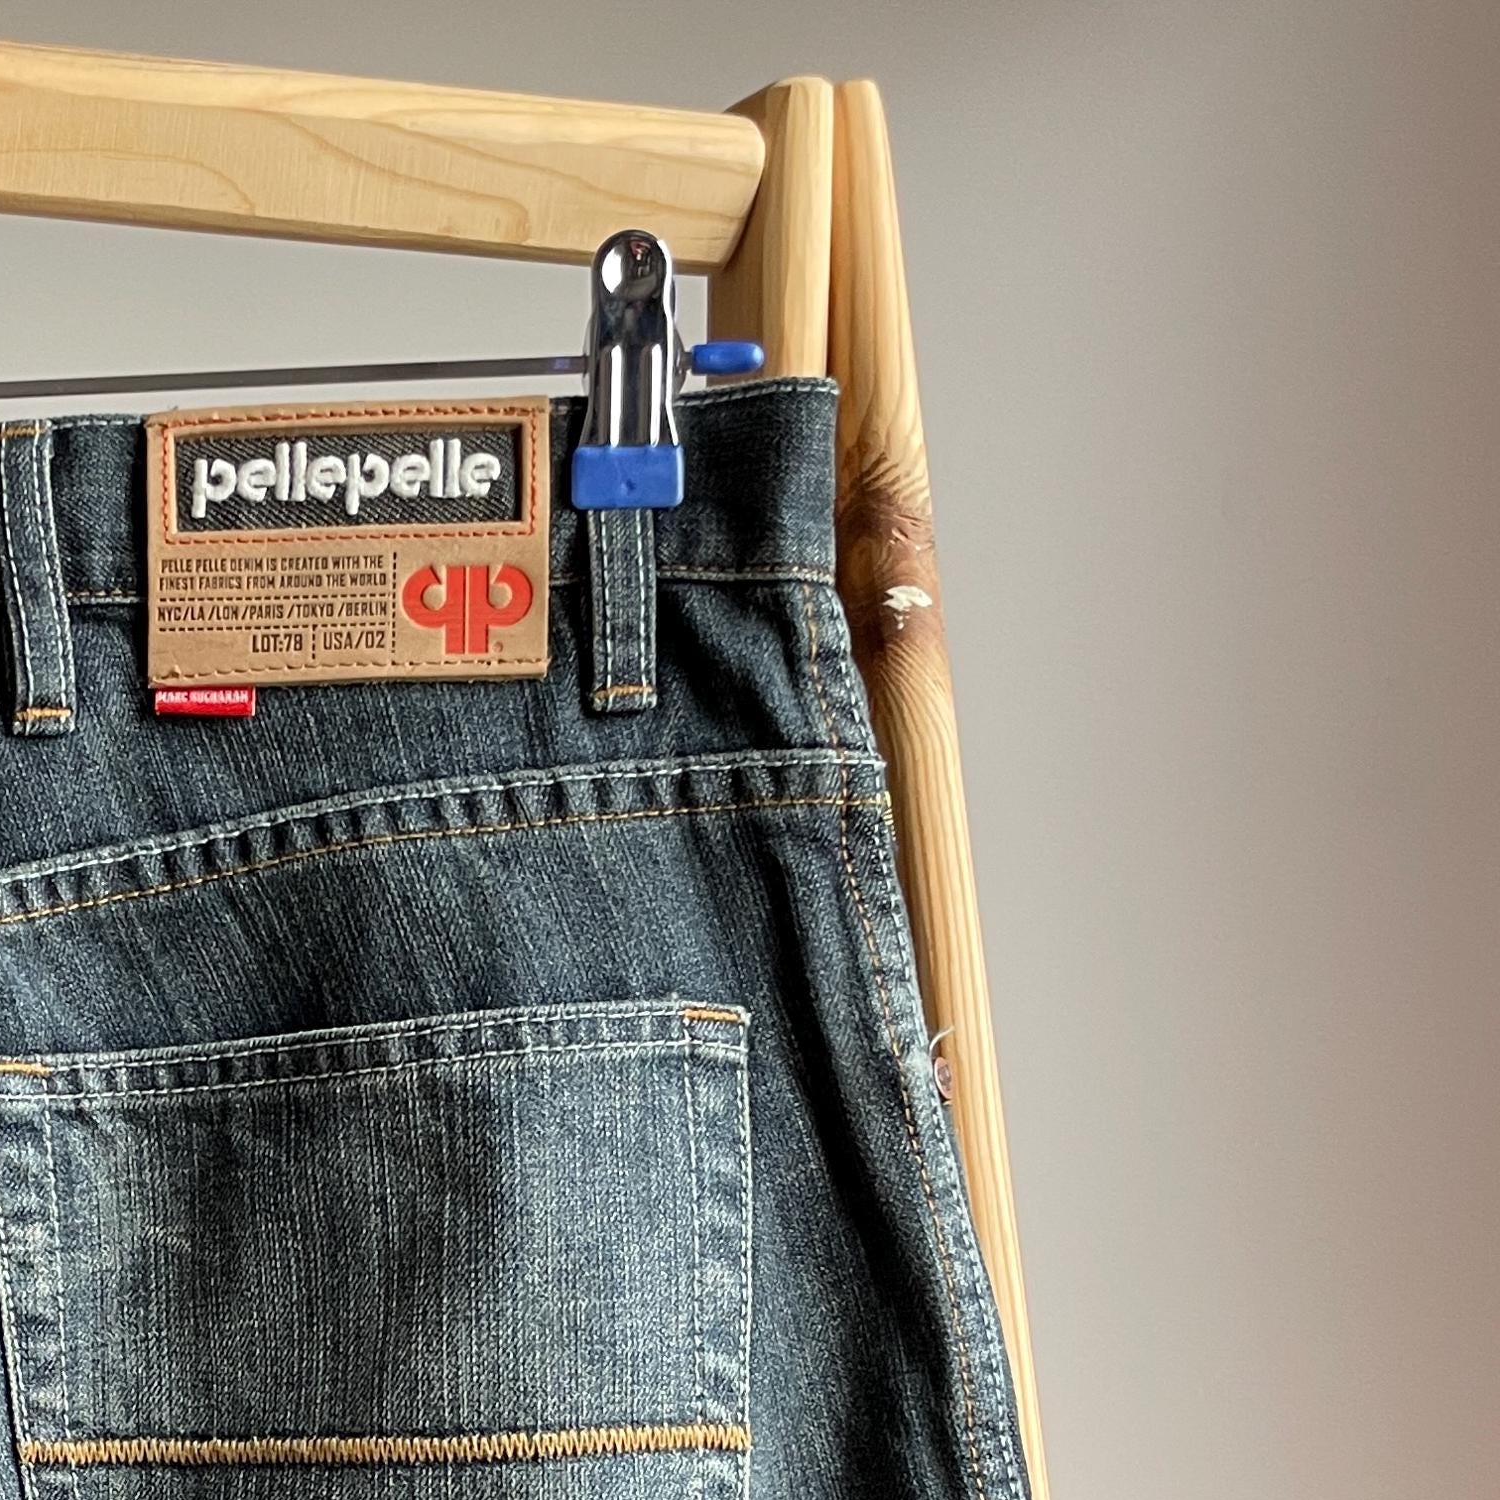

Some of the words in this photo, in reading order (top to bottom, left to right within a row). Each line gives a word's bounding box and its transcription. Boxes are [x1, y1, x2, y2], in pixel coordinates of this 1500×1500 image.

[191, 438, 501, 519] pellepelle
[161, 558, 193, 573] PELLE
[195, 558, 227, 573] PELLE
[230, 557, 263, 572] DENIM
[266, 558, 277, 571] IS
[280, 556, 329, 571] CREATED
[331, 555, 360, 570] WITH
[363, 554, 384, 569] THE
[159, 576, 195, 591] FINEST
[198, 576, 242, 590] FABRICS
[246, 576, 276, 590] FROM
[279, 573, 323, 588] AROUND
[326, 573, 347, 588] THE
[349, 572, 387, 587] WORLD
[251, 633, 304, 653] LOT:78
[322, 630, 386, 650] USA/02
